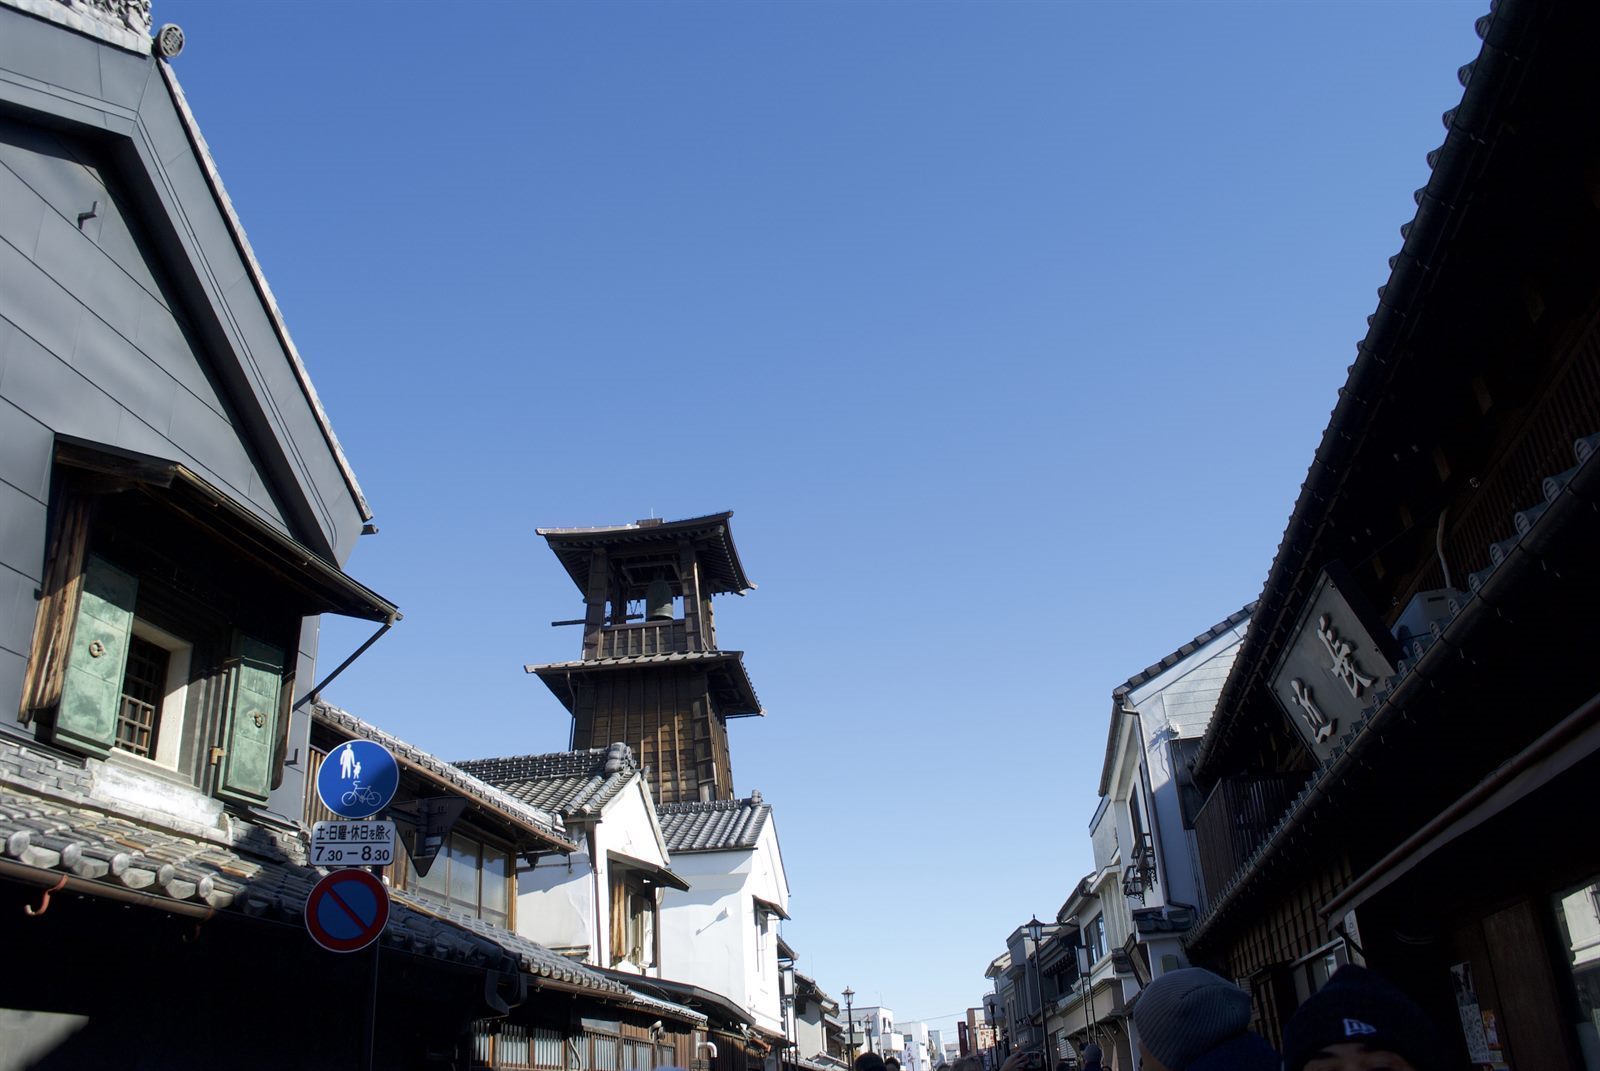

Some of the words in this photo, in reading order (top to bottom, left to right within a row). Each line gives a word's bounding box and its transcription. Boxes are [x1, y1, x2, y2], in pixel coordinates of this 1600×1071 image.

[316, 825, 391, 840] 土・日曜・休日を除く
